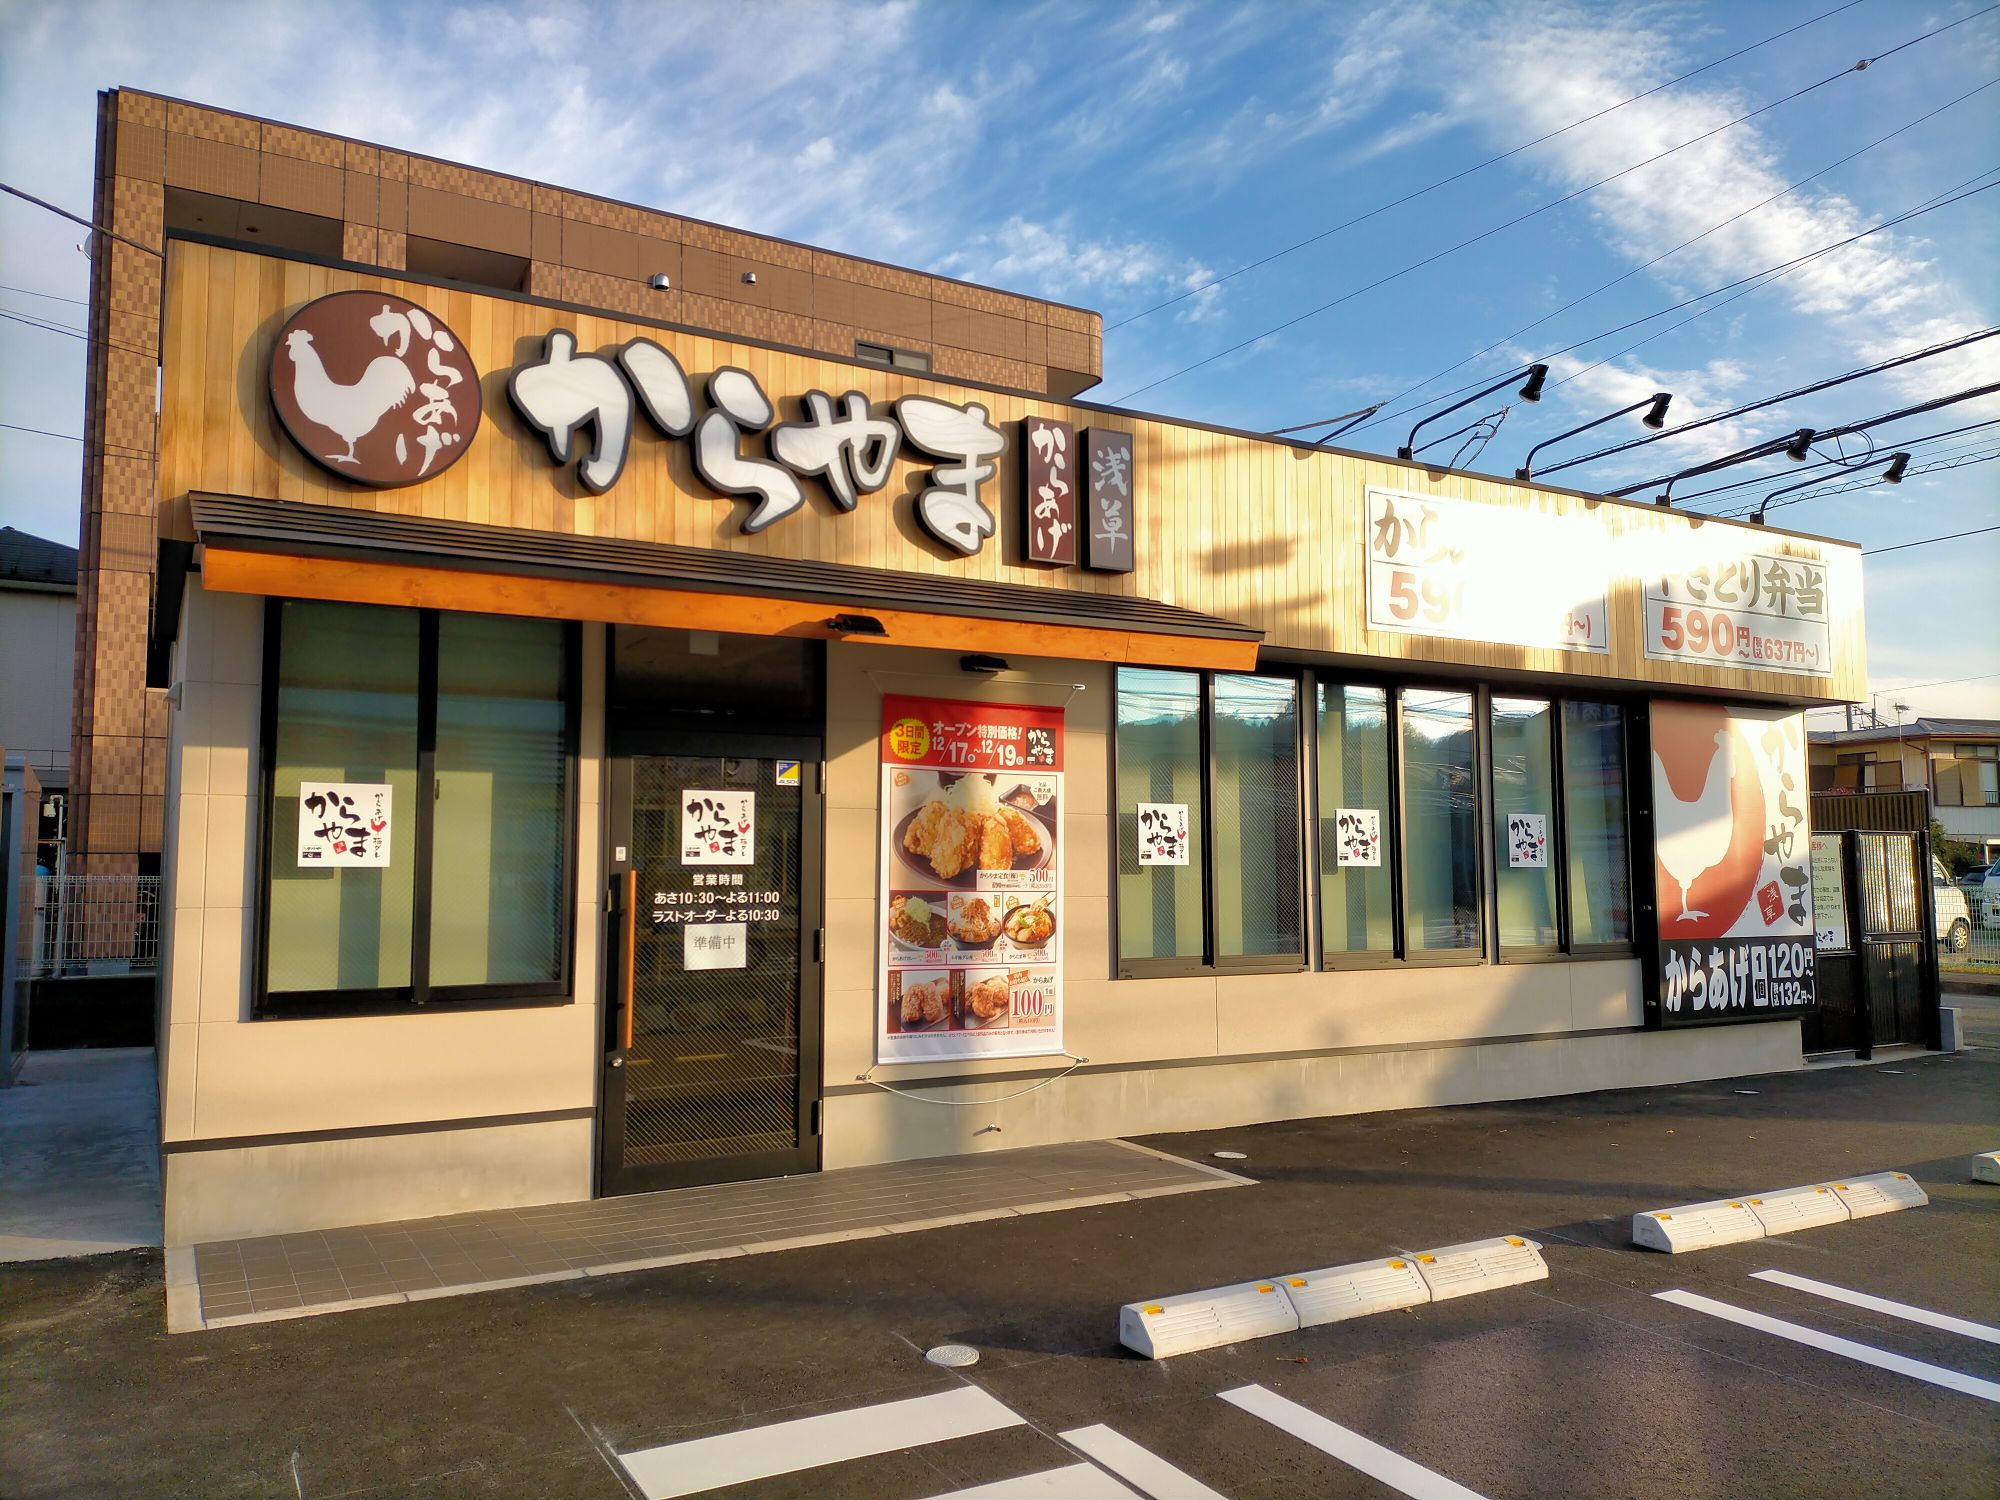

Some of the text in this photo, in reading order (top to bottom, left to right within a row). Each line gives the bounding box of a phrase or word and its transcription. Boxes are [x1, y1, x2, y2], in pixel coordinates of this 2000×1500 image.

[370, 305, 463, 476] からあげ
[511, 330, 1006, 554] からやま
[1031, 423, 1072, 559] からあげ
[1092, 447, 1131, 553] 浅草
[895, 724, 924, 739] 3日間
[897, 740, 922, 755] 限定
[692, 874, 744, 886] 営業時間
[652, 909, 780, 923] ラストオーダーよる10:30
[693, 935, 736, 951] 準備中
[1665, 943, 1750, 1012] からあげ
